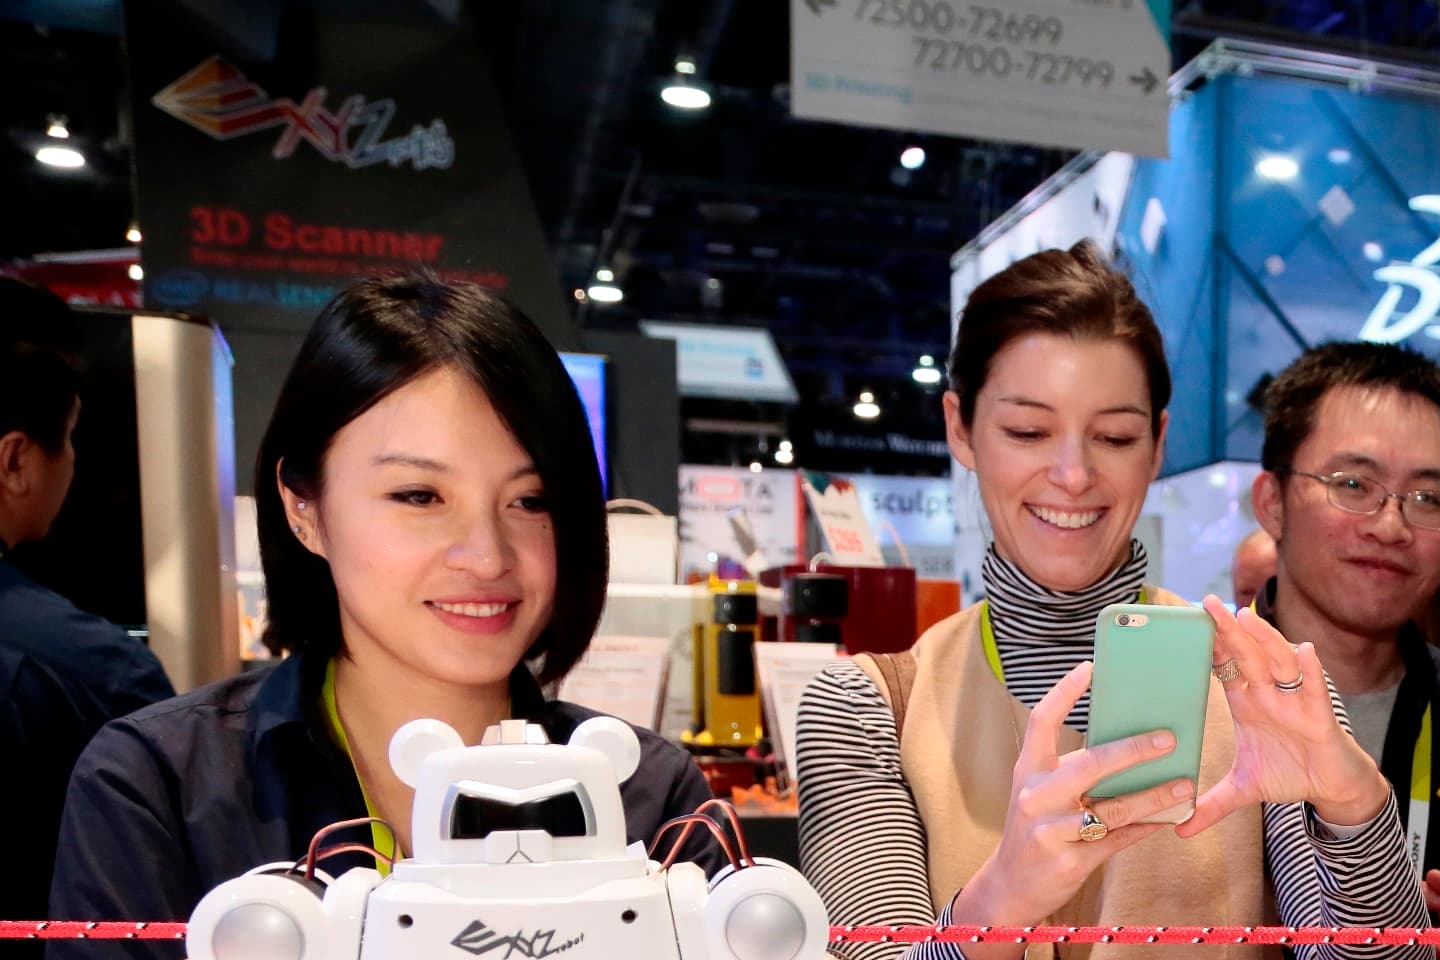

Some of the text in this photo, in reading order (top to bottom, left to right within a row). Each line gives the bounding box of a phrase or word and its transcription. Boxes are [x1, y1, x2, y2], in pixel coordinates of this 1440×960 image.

[911, 36, 1116, 87] 72700-72799
[190, 206, 443, 262] 3D Scanner
